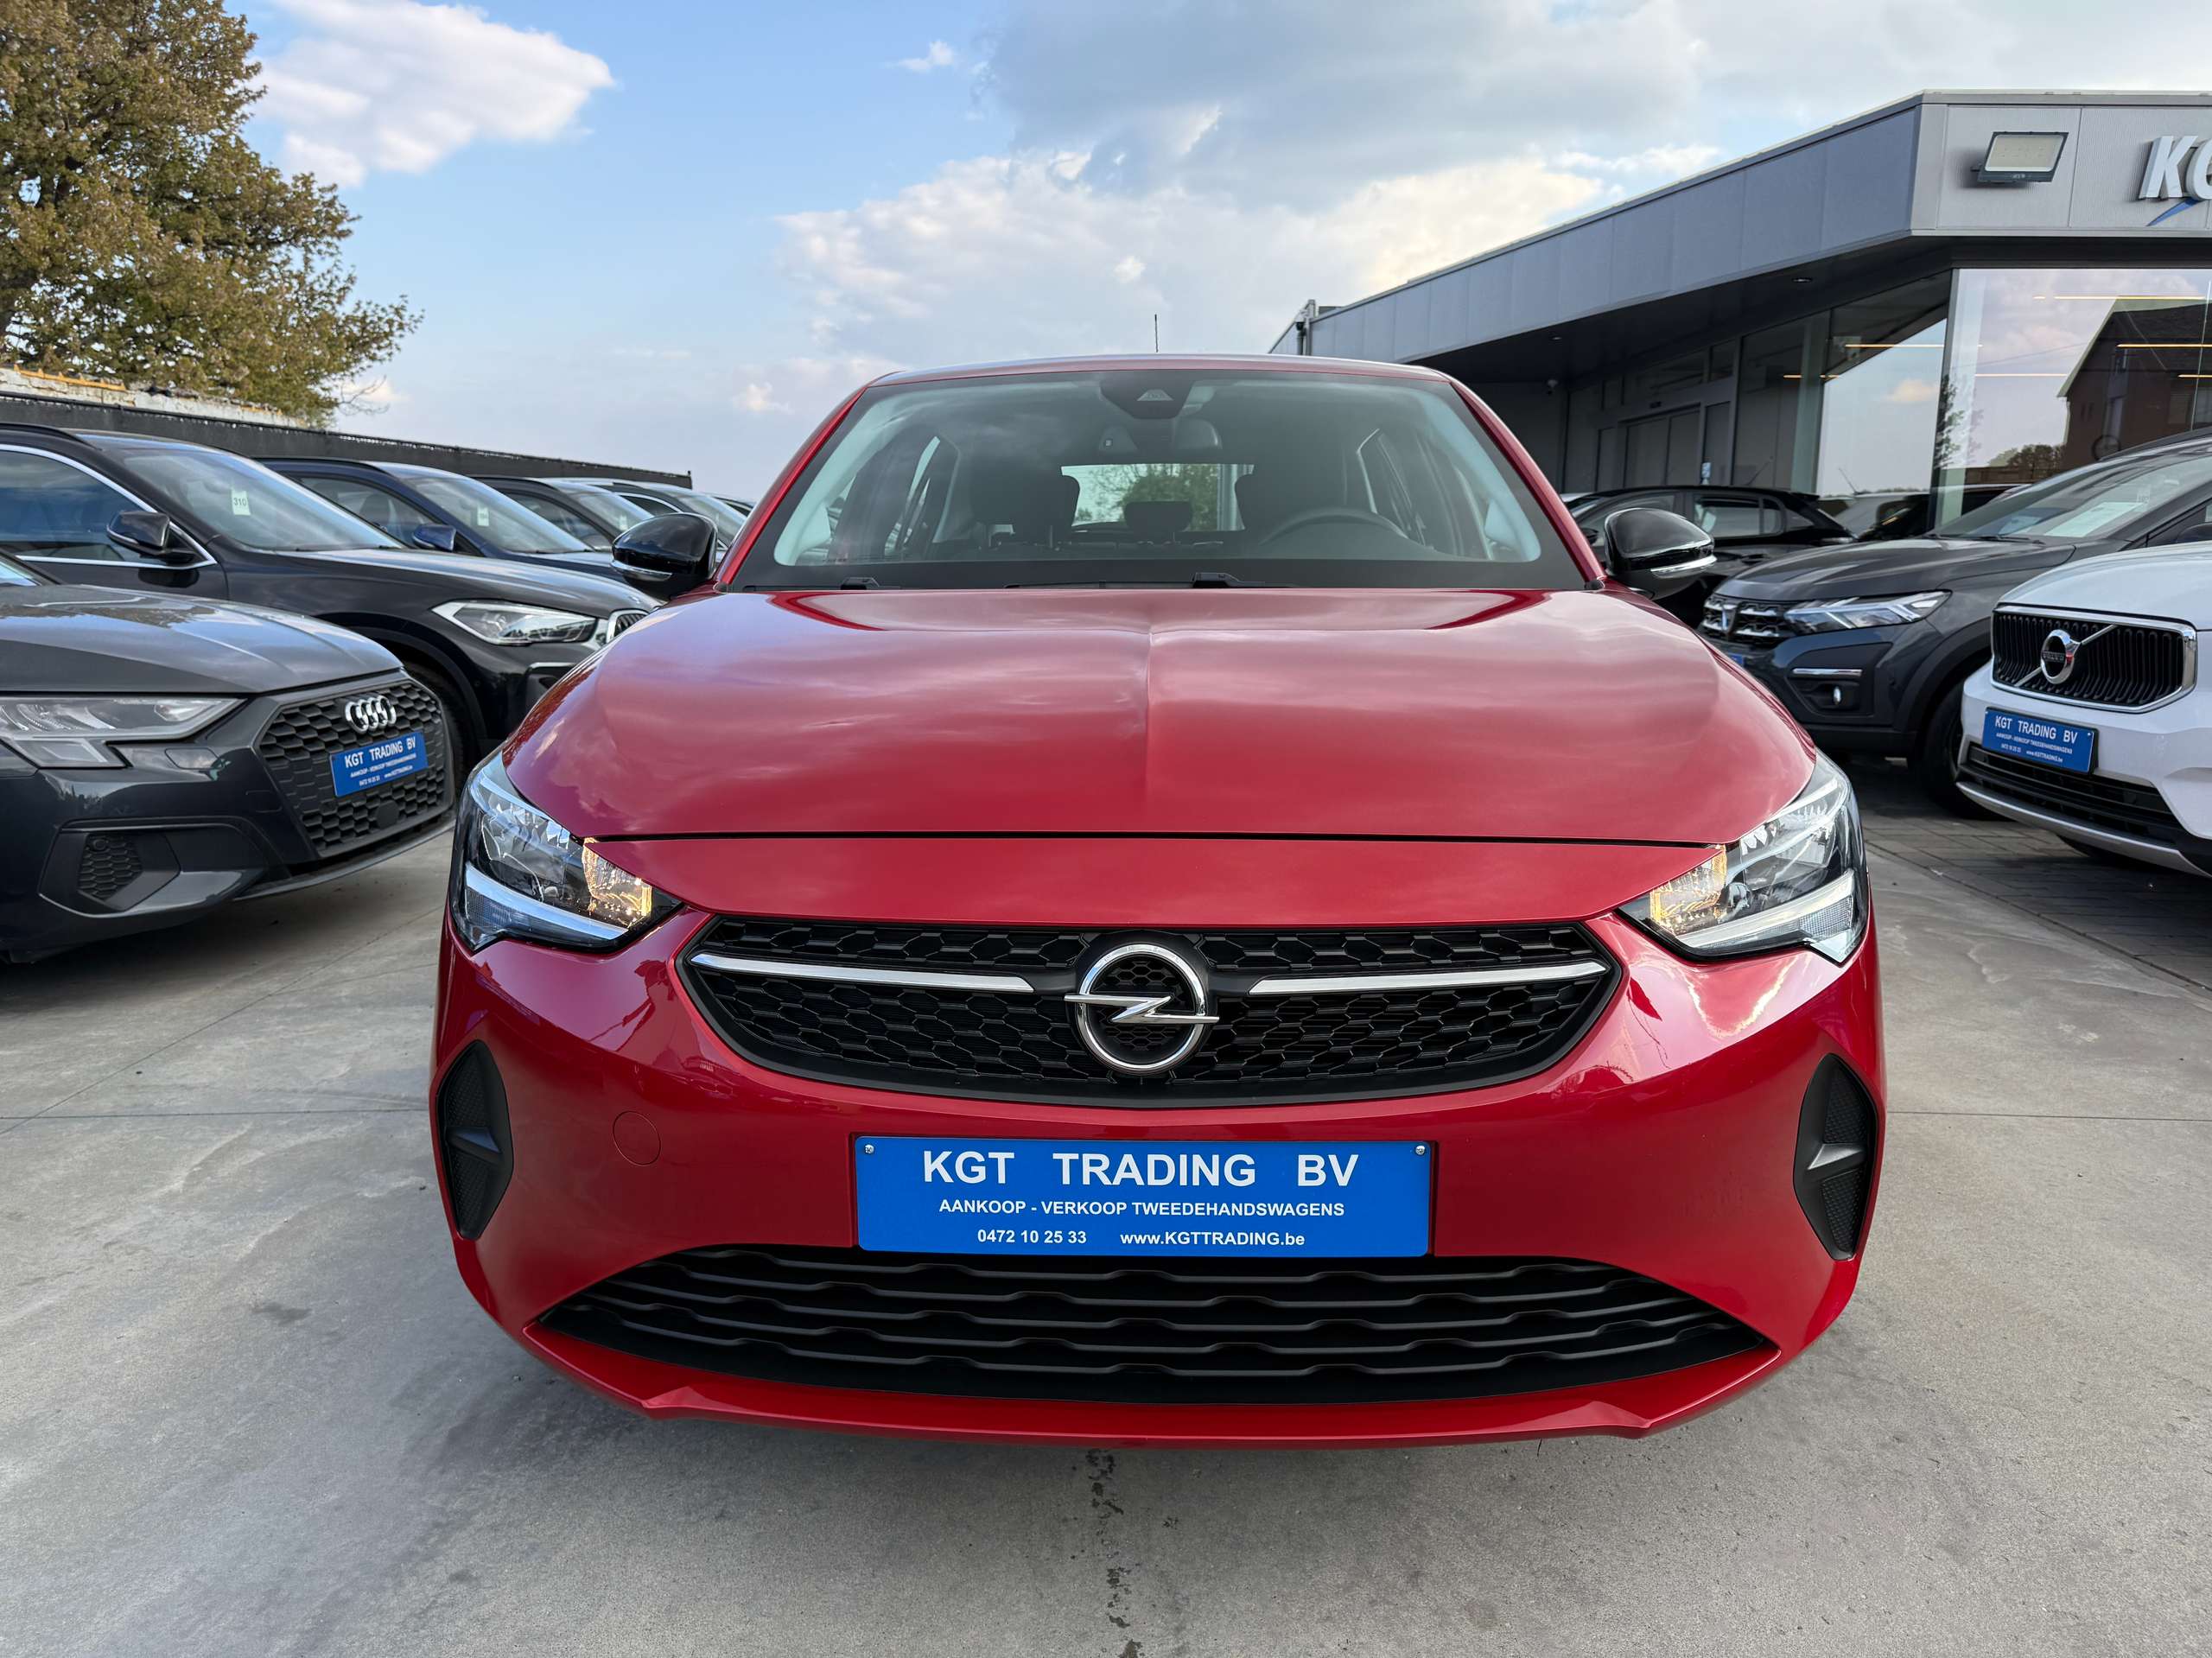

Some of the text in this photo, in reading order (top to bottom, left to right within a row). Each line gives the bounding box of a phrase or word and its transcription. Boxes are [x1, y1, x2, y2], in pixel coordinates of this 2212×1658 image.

[1995, 715, 2012, 730] KGT
[2018, 721, 2056, 740] TRADING
[2063, 730, 2078, 744] BV
[344, 752, 364, 768] KGT
[369, 740, 404, 761] TRADING
[407, 736, 416, 750] BV
[924, 1150, 1359, 1187] KGT TRADING BV
[939, 1199, 1026, 1214] AANKOOP
[1041, 1201, 1127, 1215] VERKOOP
[1132, 1202, 1344, 1217] TWEEDEHANDSWAGENS
[977, 1229, 1306, 1246] 0472 10 25 33 www.KGTTRADING.be
